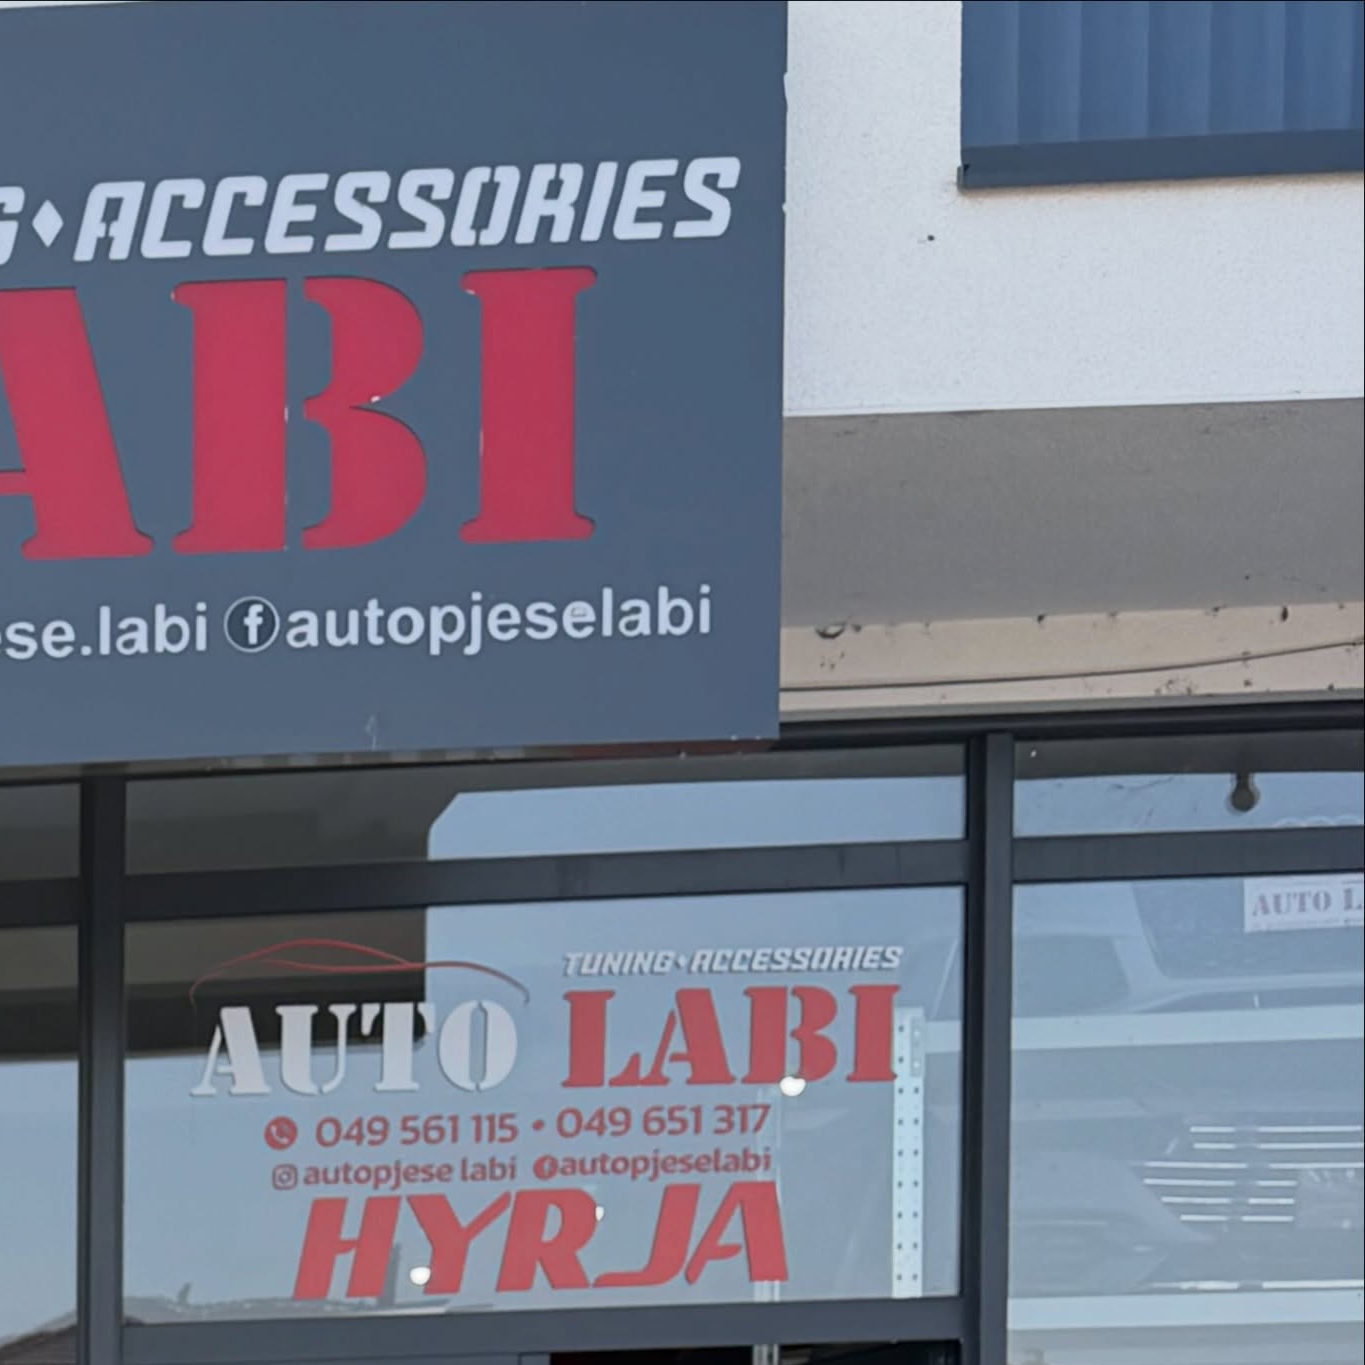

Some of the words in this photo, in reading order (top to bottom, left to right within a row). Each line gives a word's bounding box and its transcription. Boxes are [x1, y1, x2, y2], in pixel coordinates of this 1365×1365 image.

[73, 156, 741, 262] ACCESSORIES
[285, 585, 713, 657] autopjeselabi
[1252, 889, 1332, 917] AUTO
[562, 951, 672, 976] TUNING
[687, 946, 904, 974] ACCESSORIES
[189, 1000, 519, 1096] AUTO
[561, 984, 901, 1088] LABI
[315, 1115, 391, 1148] 049
[399, 1113, 459, 1146] 561
[470, 1112, 518, 1144] 115
[556, 1106, 633, 1139] 049
[641, 1104, 703, 1137] 651
[712, 1103, 771, 1135] 317
[559, 1146, 772, 1183] autopjeselabi
[292, 1180, 789, 1301] HYRJA
